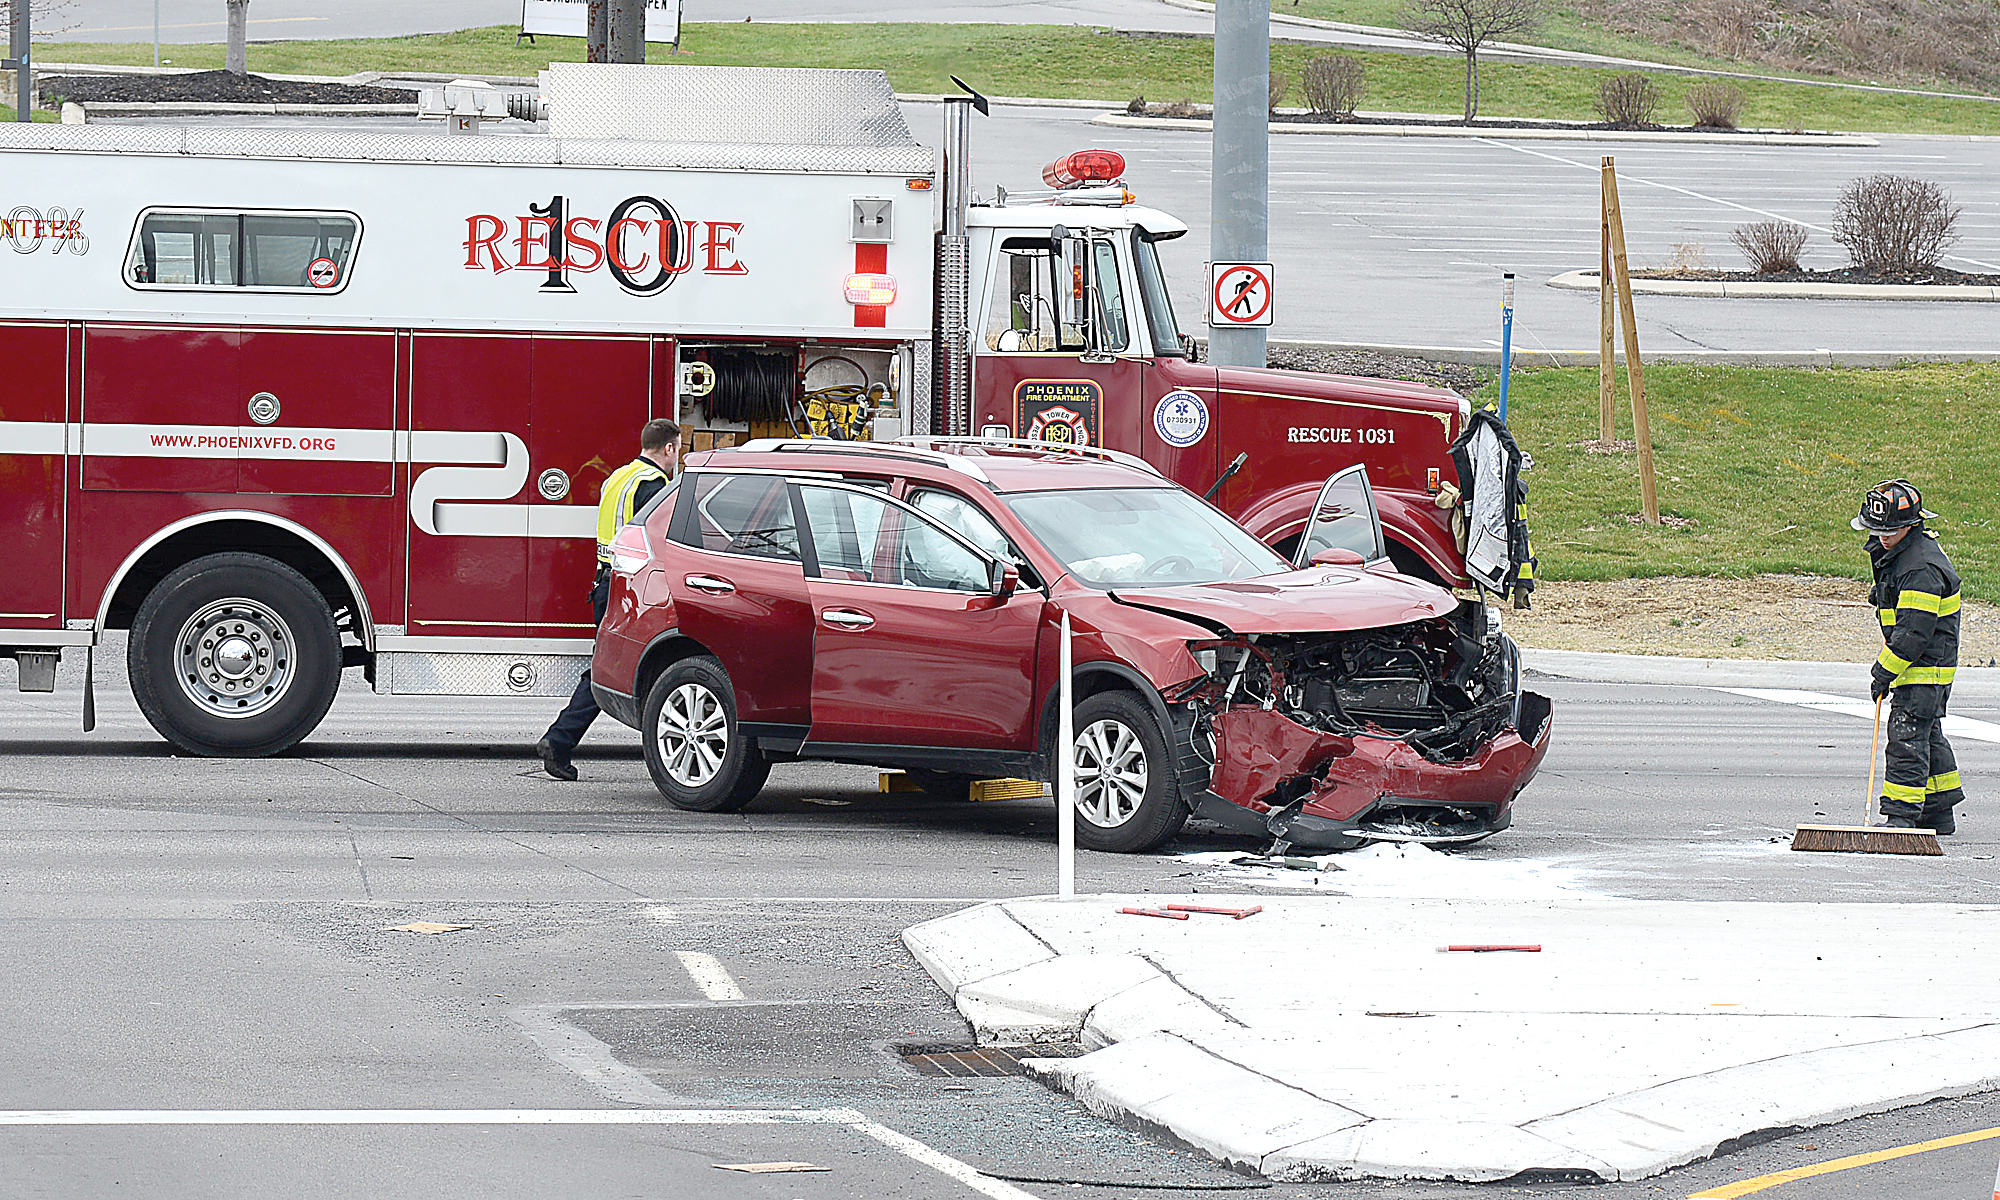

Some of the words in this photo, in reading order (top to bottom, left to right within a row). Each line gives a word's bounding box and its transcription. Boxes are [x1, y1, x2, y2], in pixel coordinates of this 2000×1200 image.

[645, 0, 667, 9] PEN
[0, 219, 85, 239] NTEER
[0, 206, 90, 256] 0%
[462, 214, 750, 276] RESCUE
[529, 195, 684, 297] 10
[1026, 394, 1042, 402] FIRE
[1043, 394, 1091, 402] DEPARTMENT
[1027, 385, 1090, 395] PHOENIX
[1046, 411, 1070, 419] TOWER
[1166, 416, 1197, 424] 0730931
[1031, 424, 1041, 451] RESCE
[1076, 425, 1085, 446] ENGIN
[1287, 427, 1352, 443] RESCUE
[1357, 428, 1396, 444] 1031
